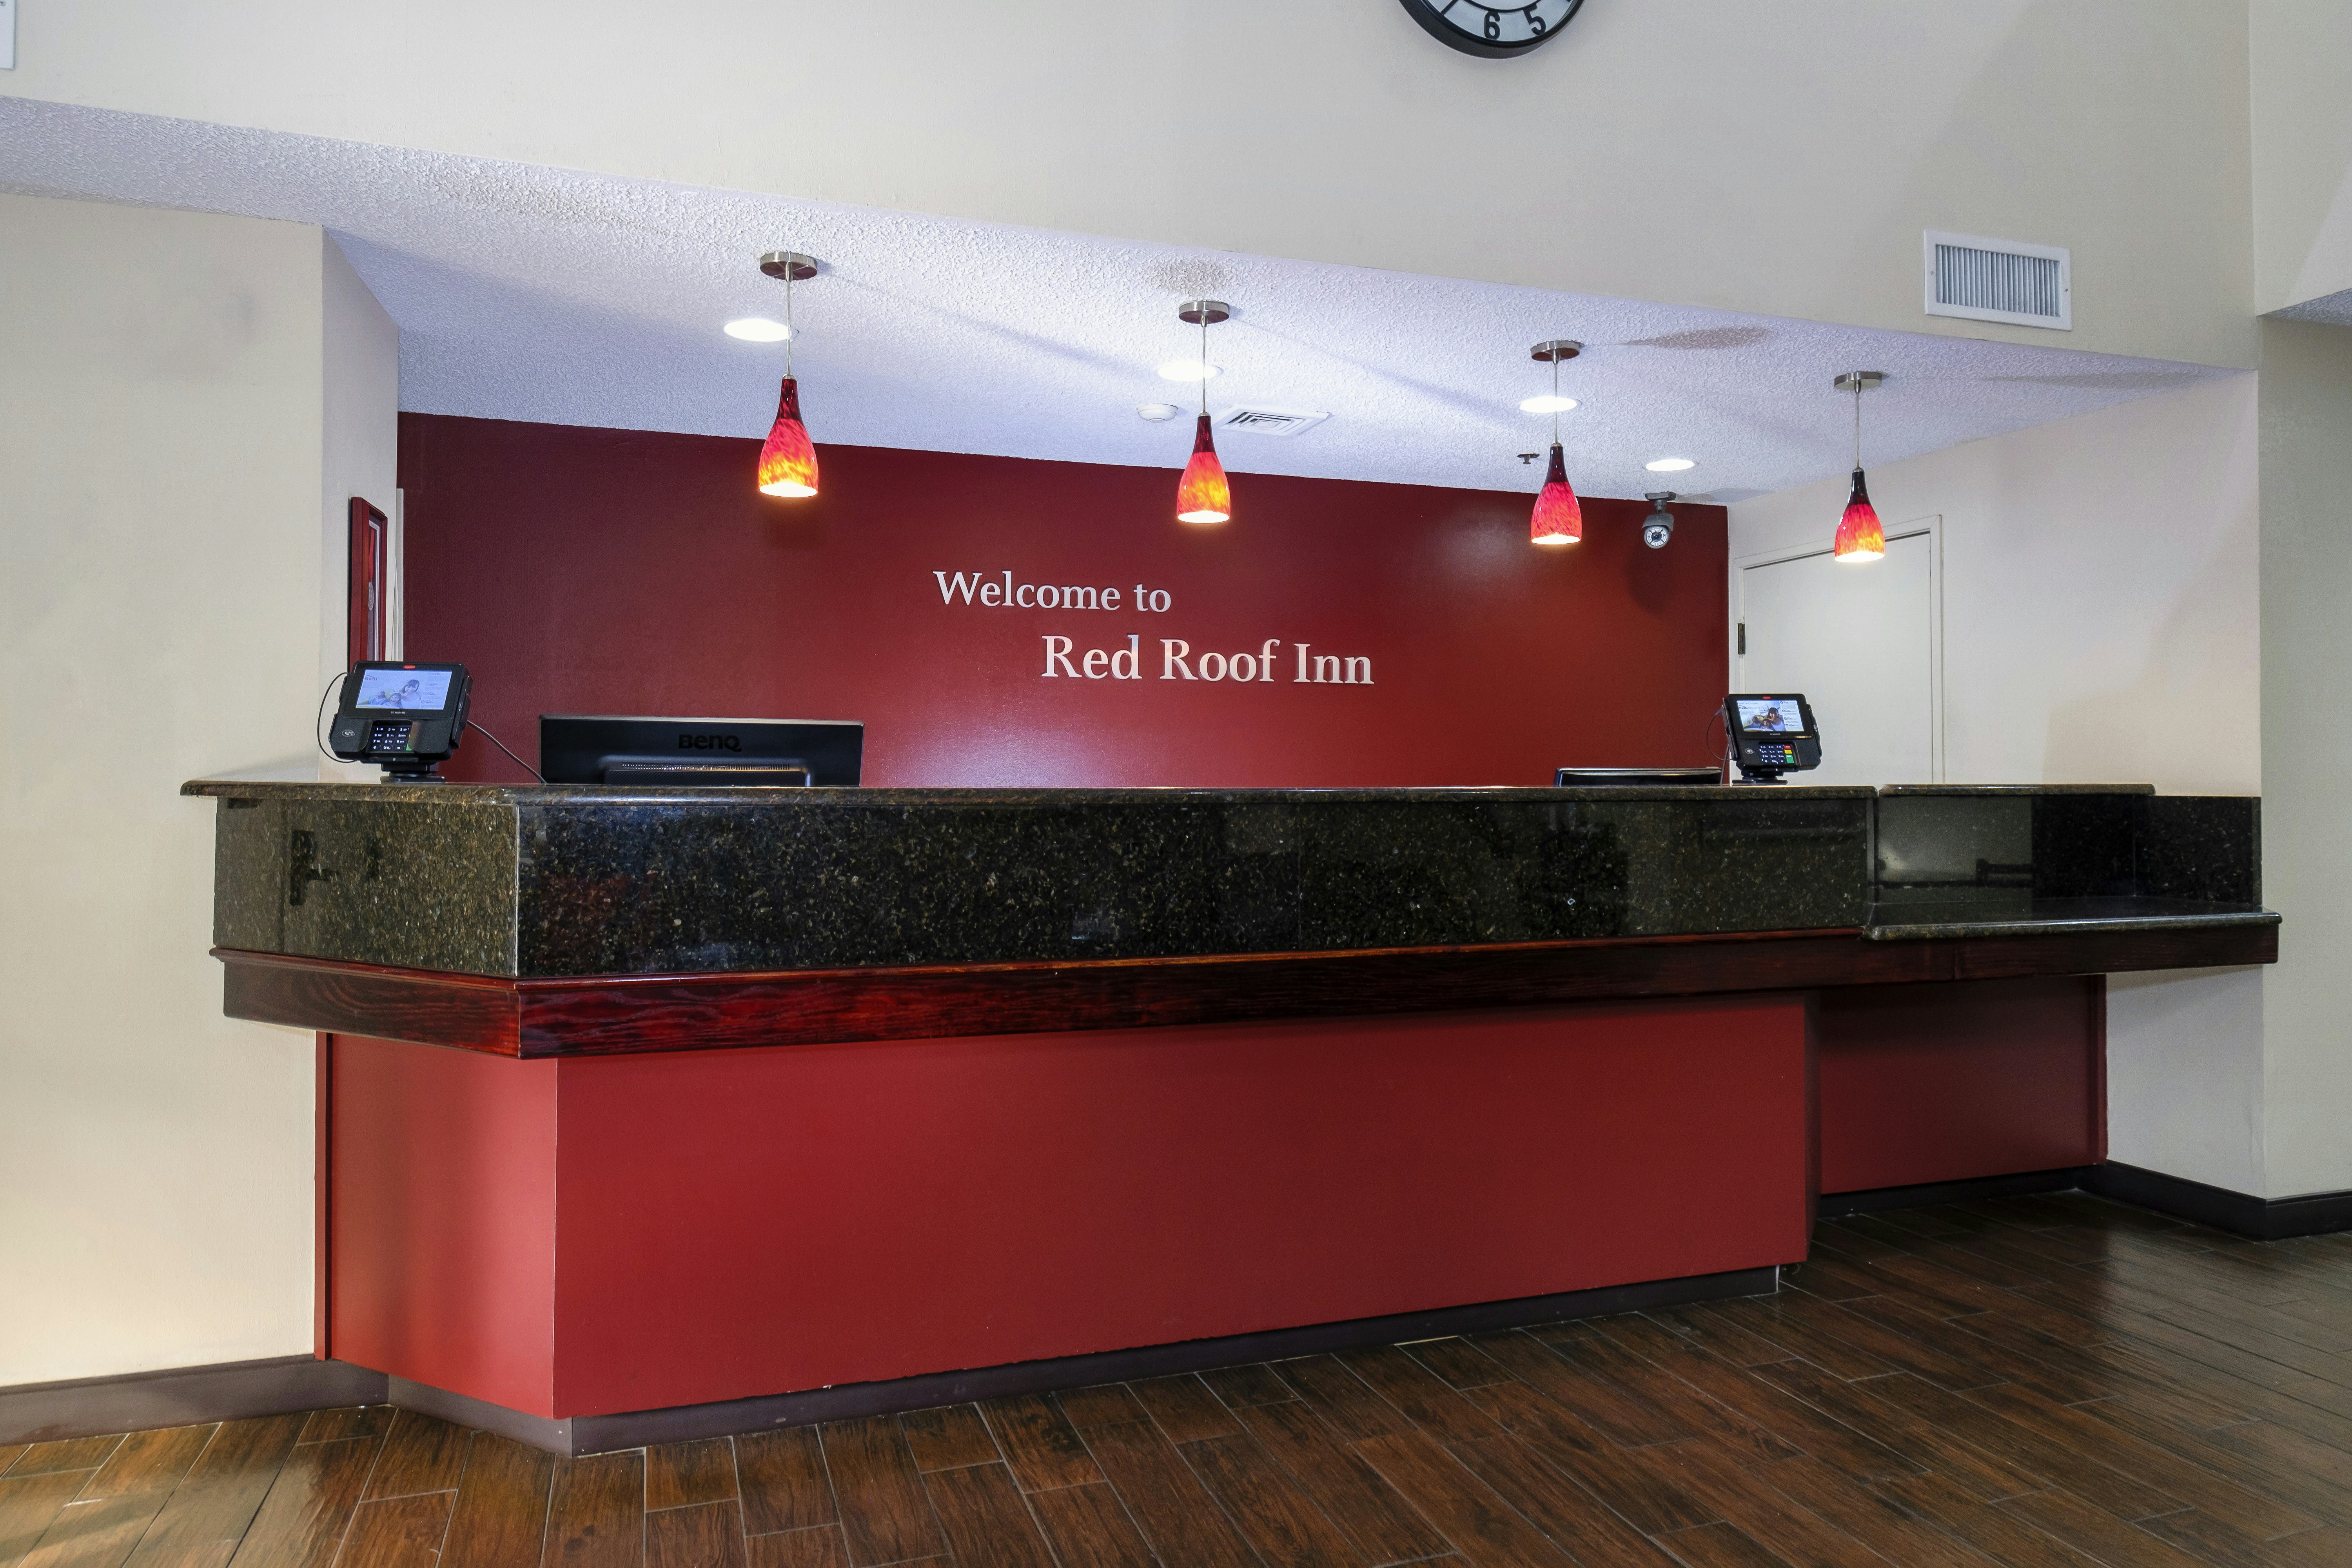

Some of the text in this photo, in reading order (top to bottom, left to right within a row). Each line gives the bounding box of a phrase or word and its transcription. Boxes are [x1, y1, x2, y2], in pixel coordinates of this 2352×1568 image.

[1484, 10, 1501, 40] 6
[1523, 3, 1546, 36] 5
[933, 570, 1171, 613] Welcome to
[1041, 634, 1375, 684] Red Roof Inn
[679, 734, 742, 752] BenQ
